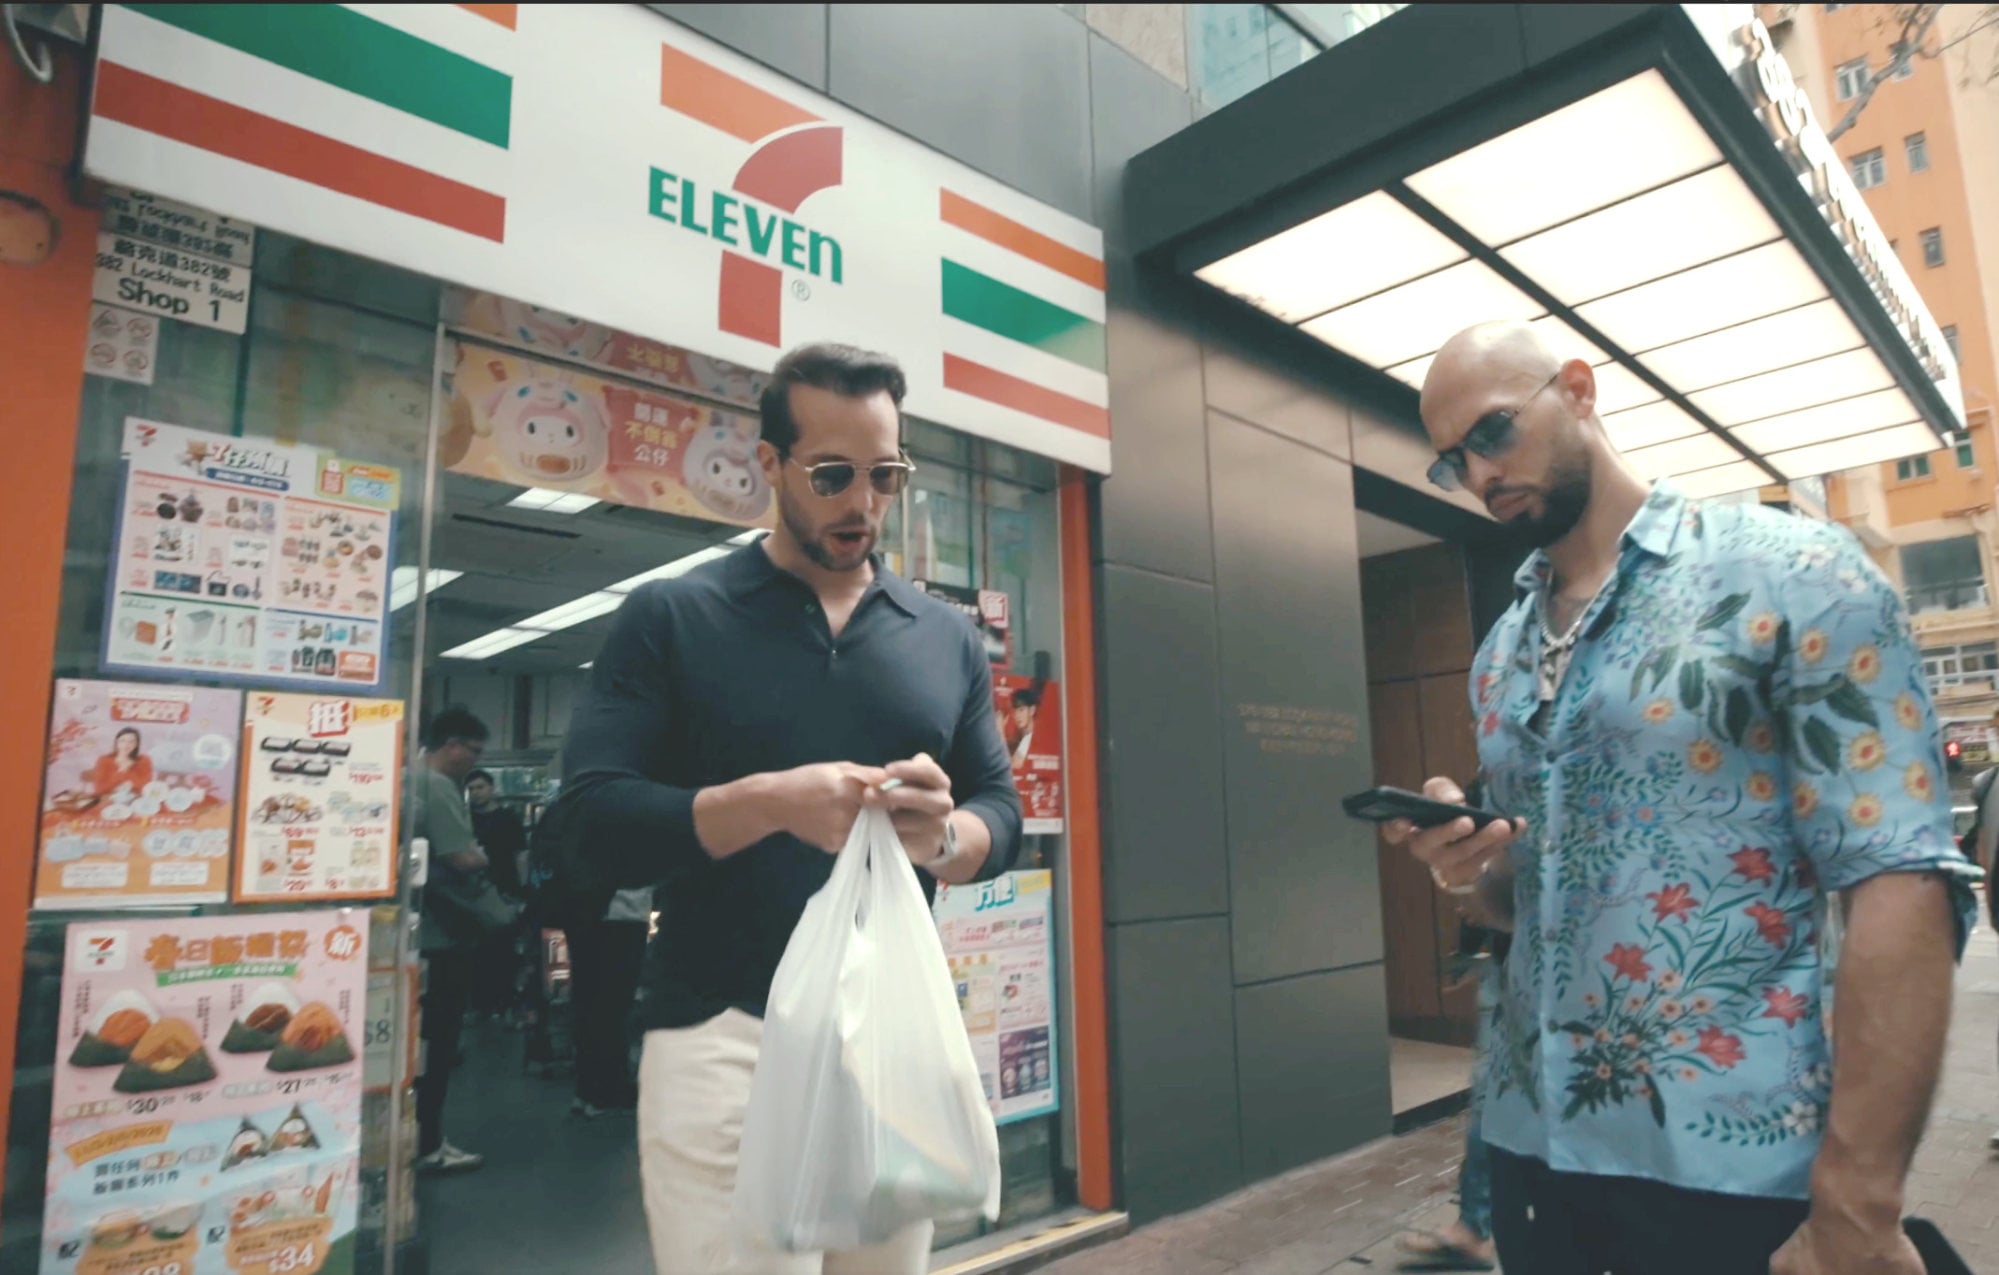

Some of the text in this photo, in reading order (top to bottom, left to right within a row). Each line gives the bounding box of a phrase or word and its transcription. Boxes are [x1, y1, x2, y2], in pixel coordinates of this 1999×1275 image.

[660, 41, 843, 348] 7
[116, 277, 222, 322] Shop 1
[130, 261, 202, 293] Lockhart
[209, 282, 245, 303] Road
